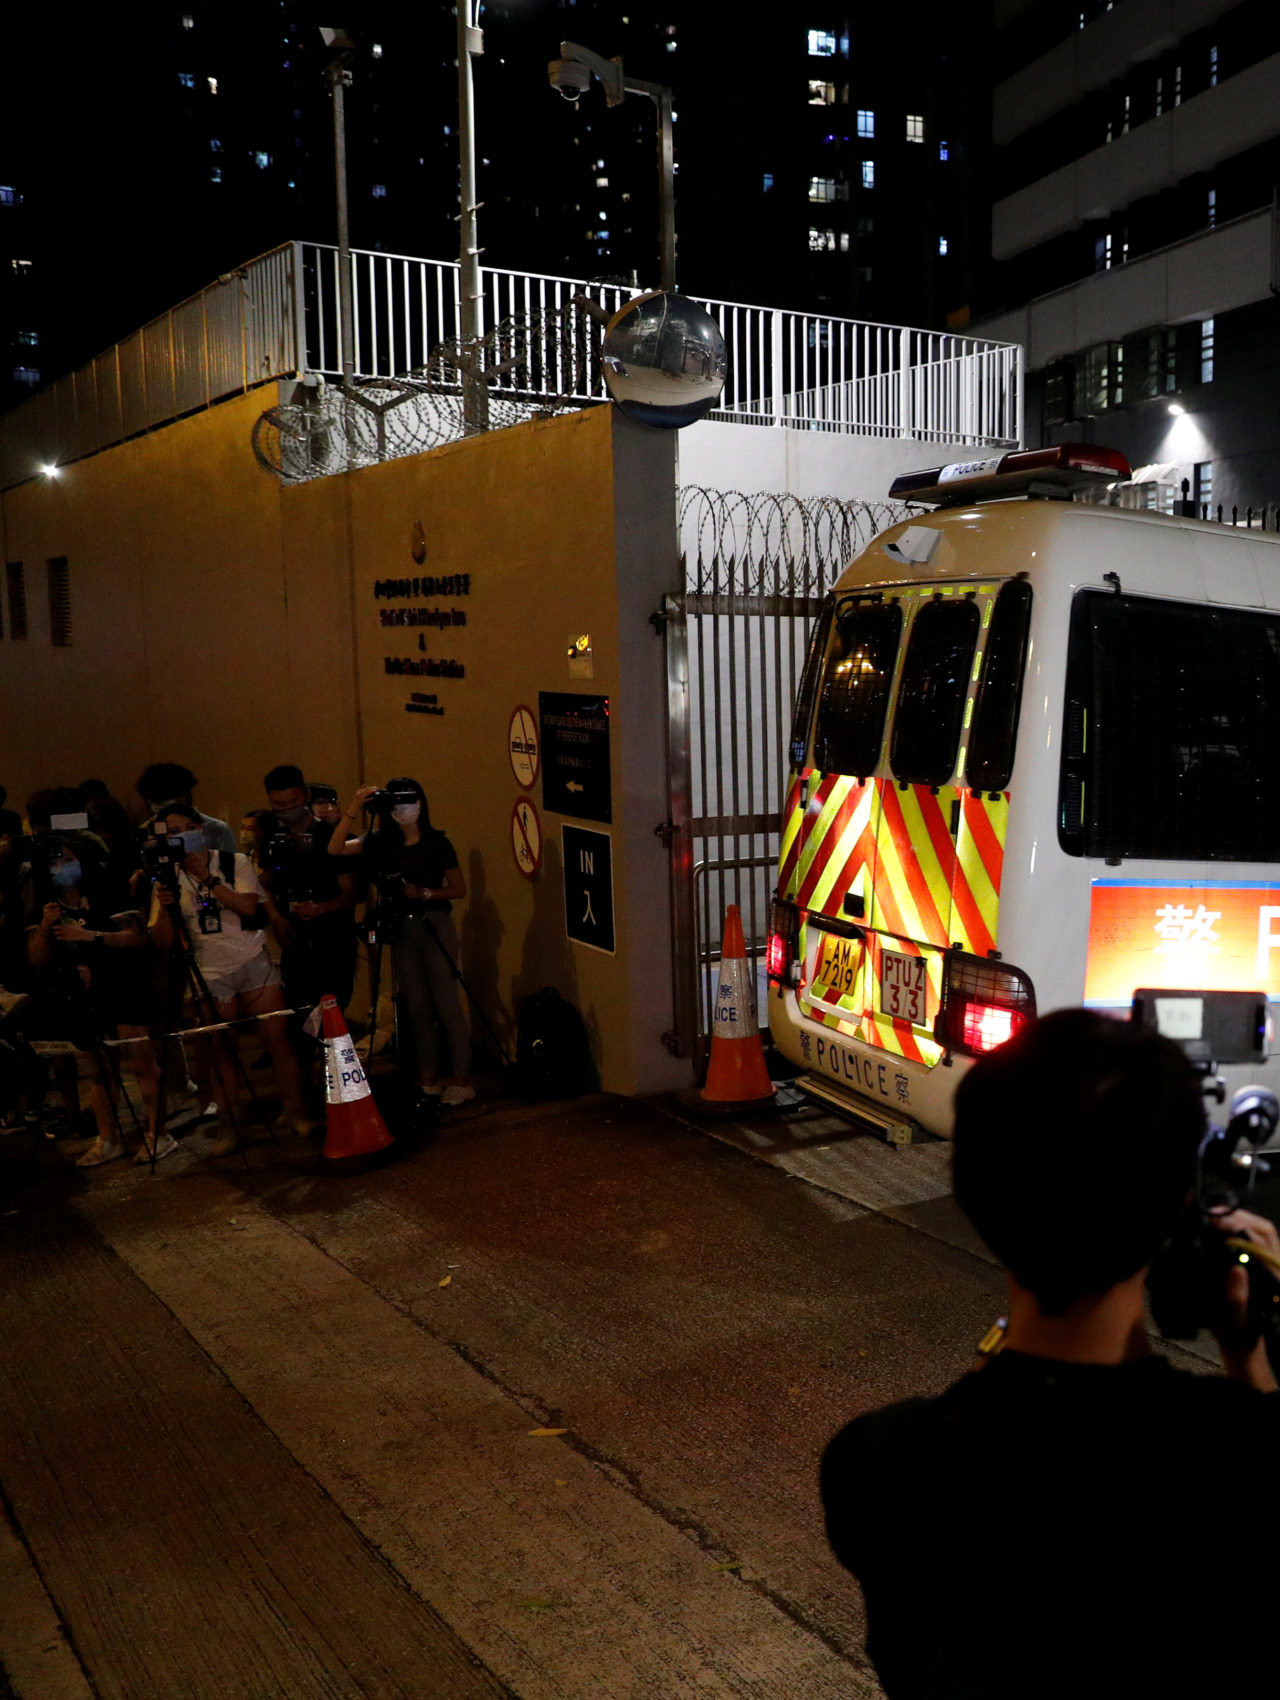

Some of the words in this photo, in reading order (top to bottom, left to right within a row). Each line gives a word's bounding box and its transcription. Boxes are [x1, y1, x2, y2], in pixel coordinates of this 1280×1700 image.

[952, 462, 986, 476] POLICE
[579, 848, 595, 876] IN
[582, 890, 597, 926] 入
[832, 940, 851, 967] AM
[821, 961, 853, 992] 7219
[817, 1038, 888, 1097] POLICE
